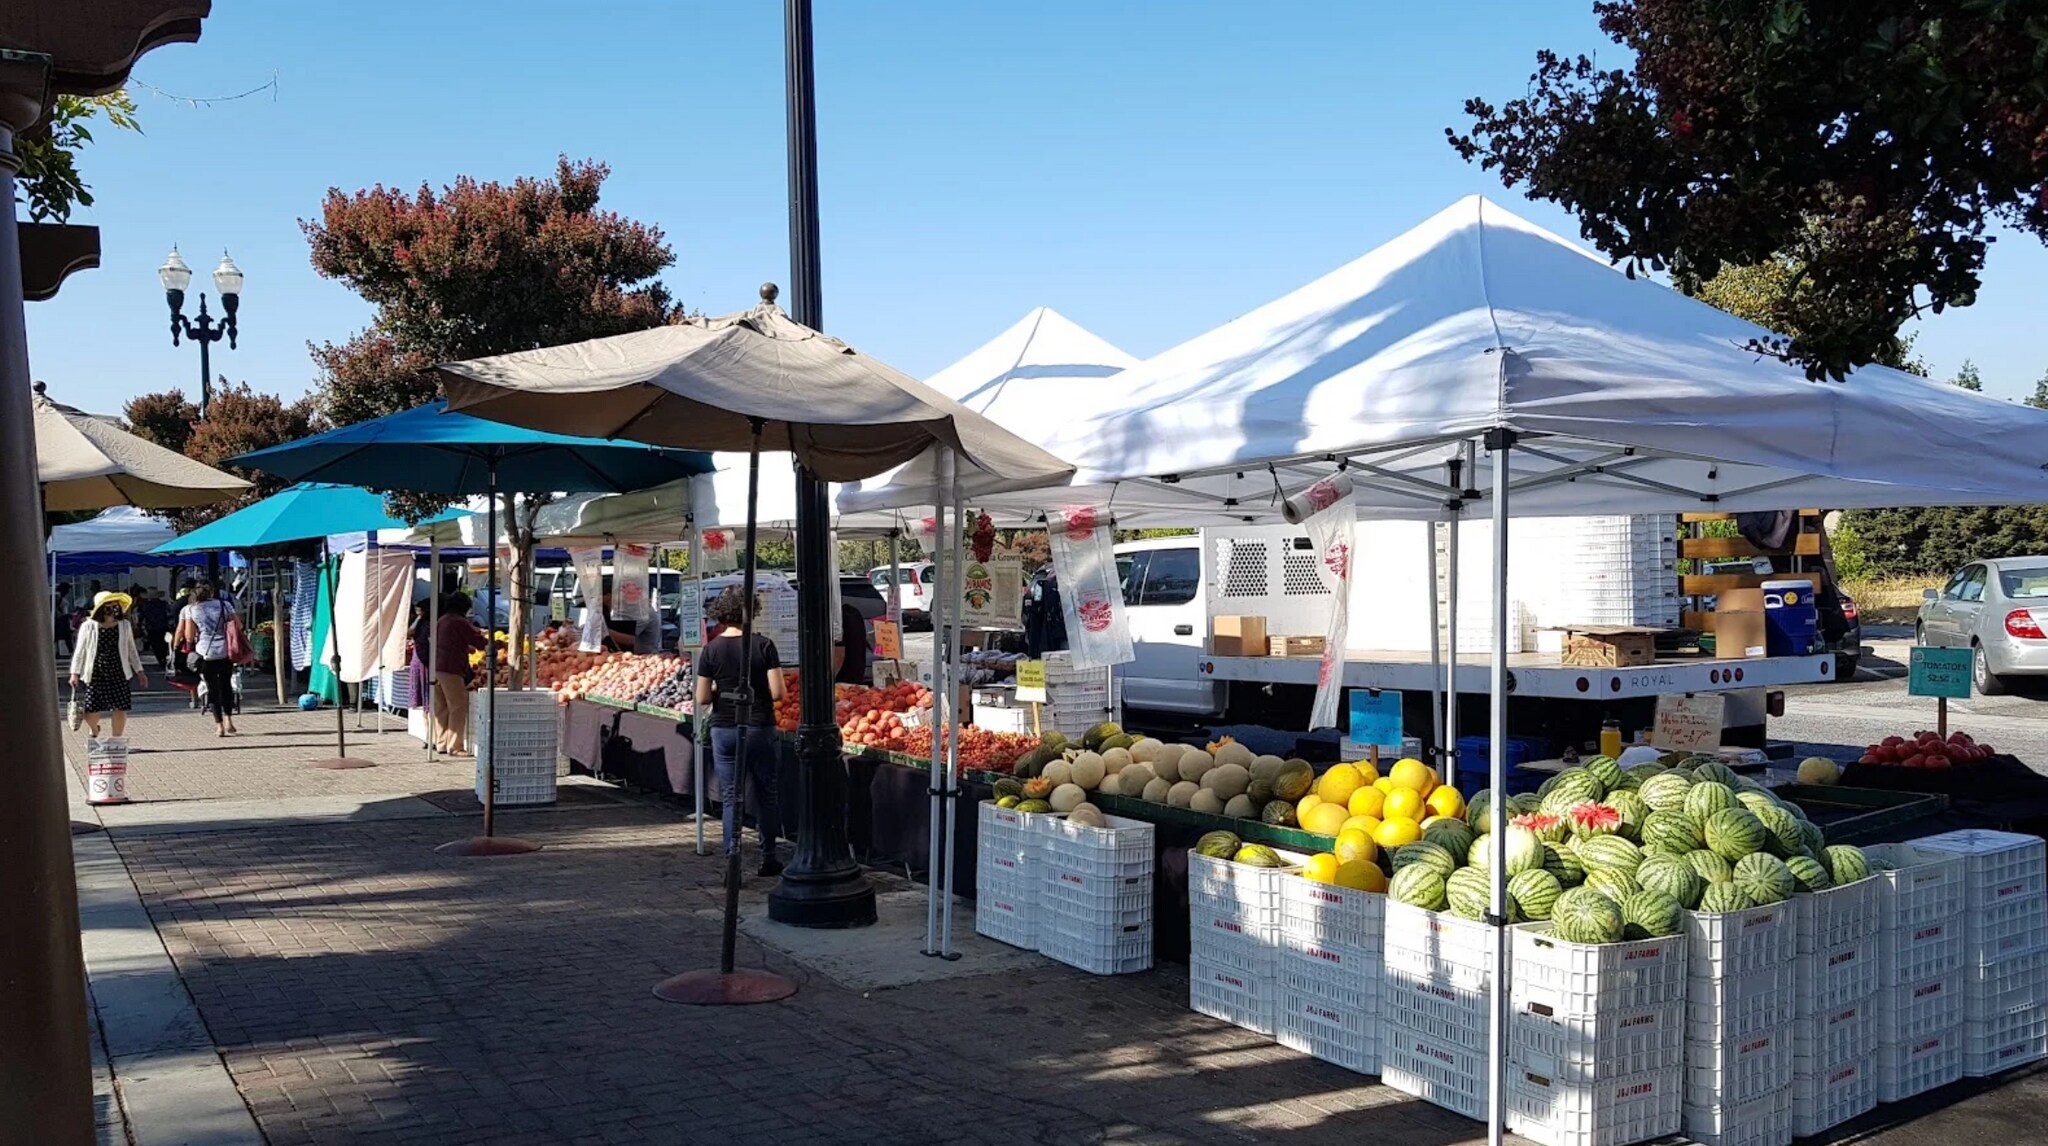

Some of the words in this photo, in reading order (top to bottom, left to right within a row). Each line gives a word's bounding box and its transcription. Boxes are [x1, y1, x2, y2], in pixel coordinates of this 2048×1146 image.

[1922, 661, 1968, 671] TOMATOES
[1631, 674, 1675, 688] ROYAL
[1321, 891, 1343, 904] FARMS
[1319, 950, 1340, 963] FARMS
[1638, 948, 1659, 959] FARMS
[1226, 976, 1242, 988] FARMS
[1416, 982, 1430, 993] J&J
[1431, 986, 1454, 1001] FARMS
[1319, 1008, 1340, 1022] FARMS
[1632, 1014, 1654, 1026] FARMS
[1416, 1043, 1429, 1055] J&J
[1430, 1048, 1454, 1064] FARMS
[1630, 1082, 1652, 1095] FARMS
